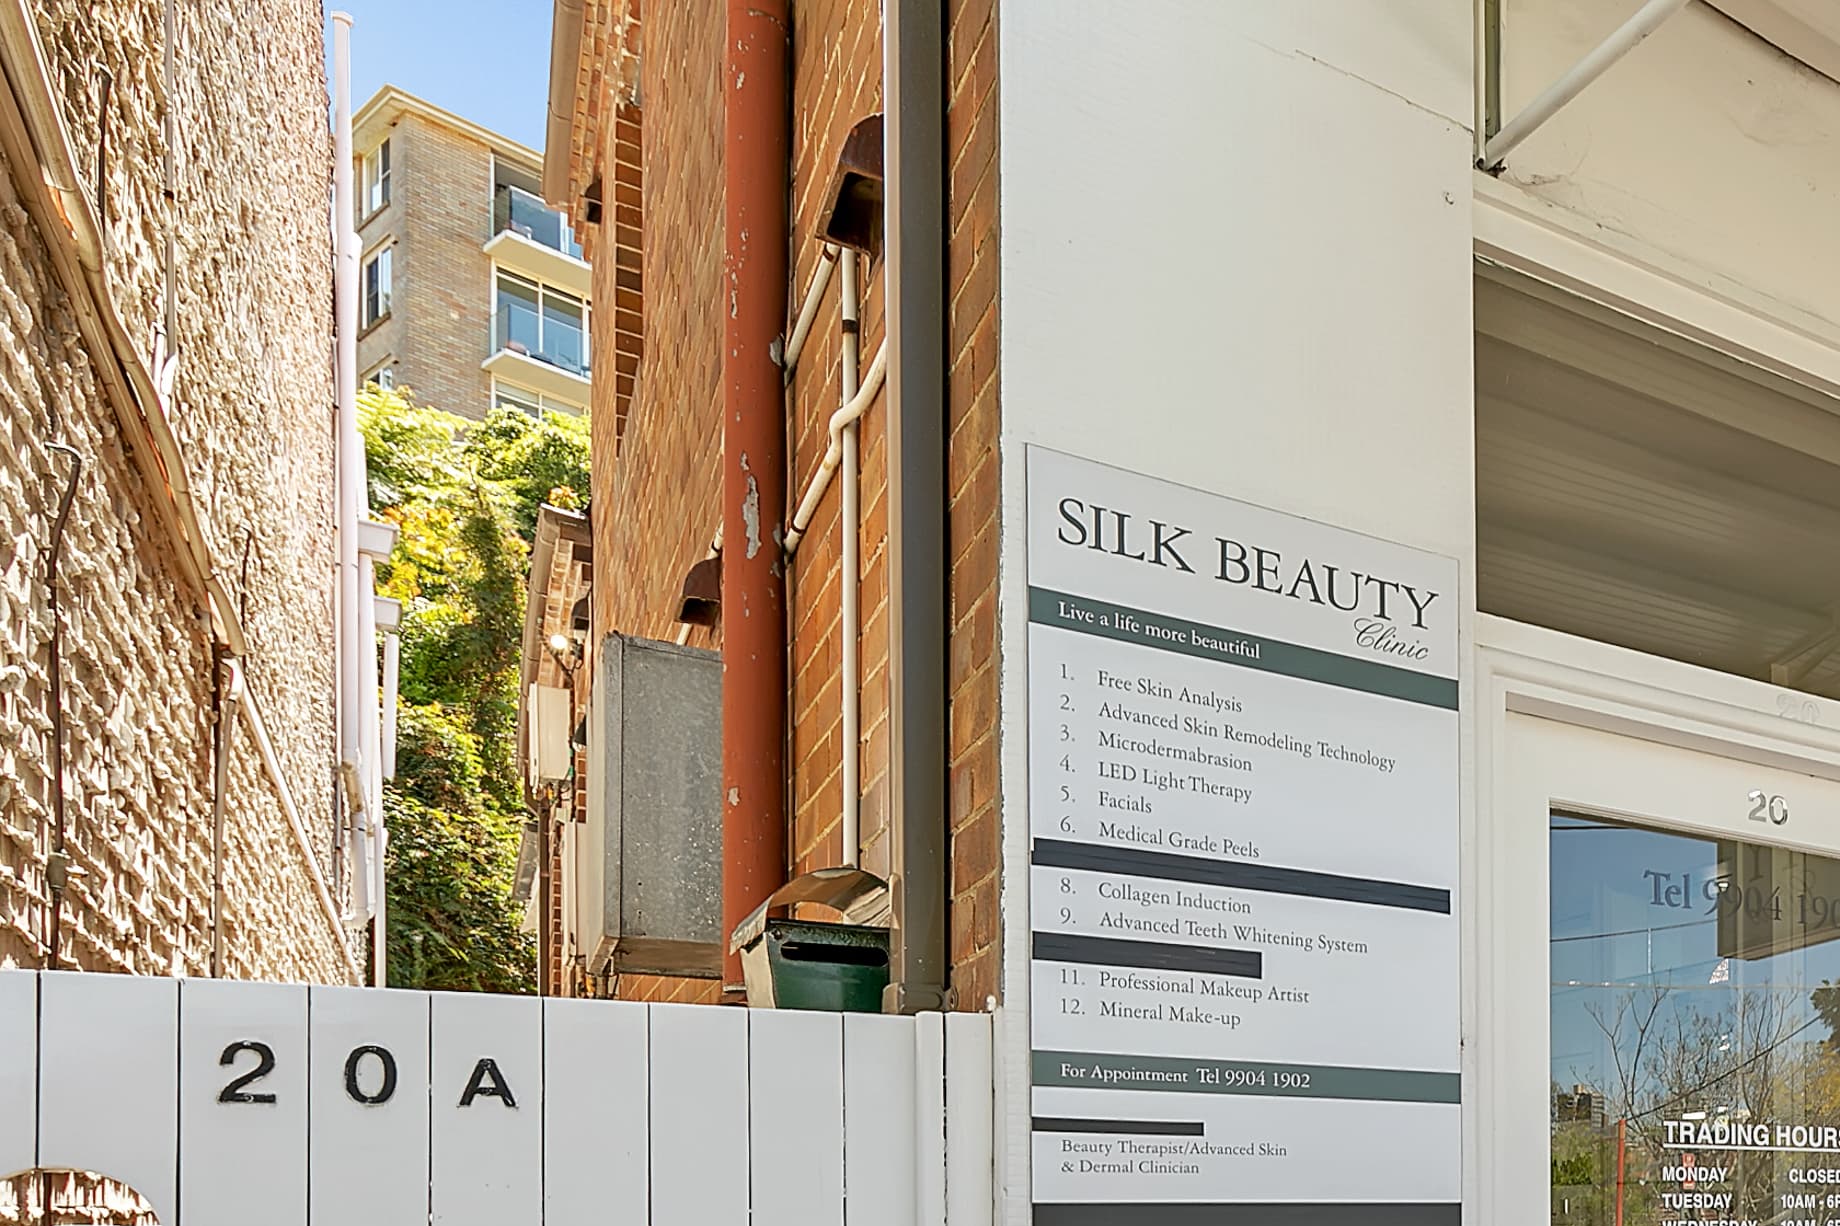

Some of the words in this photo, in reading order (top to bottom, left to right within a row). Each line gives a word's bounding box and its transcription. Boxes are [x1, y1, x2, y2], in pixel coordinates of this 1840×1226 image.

[1058, 498, 1195, 574] SILK
[1215, 538, 1438, 629] BEAUTY
[1059, 601, 1094, 624] Live
[1100, 612, 1108, 626] a
[1115, 613, 1139, 633] life
[1145, 624, 1186, 644] more
[1191, 629, 1260, 659] beautiful
[1354, 618, 1429, 660] Clinic
[1061, 664, 1074, 680] 1.
[1098, 670, 1132, 693] Free
[1138, 678, 1172, 700] Skin
[1179, 687, 1242, 714] Analysis
[1061, 695, 1075, 711] 2.
[1099, 702, 1179, 732] Advanced
[1184, 717, 1217, 738] Skin
[1224, 724, 1312, 757] Remodeling
[1317, 741, 1395, 773] Technology
[1061, 725, 1075, 742] 3.
[1100, 730, 1252, 771] Microdermabrasion
[1061, 754, 1075, 773] 4.
[1099, 761, 1136, 783] LED
[1142, 767, 1184, 792] Light
[1189, 775, 1252, 803] Therapy
[1061, 786, 1075, 803] 5.
[1099, 792, 1152, 814] Facials
[1747, 788, 1789, 826] 20
[1061, 816, 1075, 833] 6.
[1100, 823, 1162, 846] Medical
[1169, 831, 1217, 852] Grade
[1223, 839, 1259, 858] Peels
[1061, 878, 1076, 894] 8.
[1099, 882, 1170, 907] Collagen
[1177, 891, 1250, 914] Induction
[1643, 869, 1690, 909] Tel
[1702, 877, 1783, 921] 9904
[1061, 908, 1076, 925] 9.
[1100, 913, 1179, 935] Advanced
[1185, 920, 1227, 940] Teeth
[1233, 925, 1312, 951] Whitening
[1318, 933, 1368, 954] System
[1061, 968, 1085, 986] 11.
[1100, 972, 1194, 995] Professional
[1200, 980, 1262, 1003] Makeup
[1268, 986, 1309, 1004] Artist
[1061, 999, 1085, 1015] 12.
[1100, 1002, 1162, 1021] Mineral
[1169, 1007, 1241, 1028] Make-up
[1061, 1063, 1085, 1077] For
[1091, 1065, 1188, 1086] Appointment
[1196, 1067, 1220, 1084] Tel
[1225, 1069, 1266, 1086] 9904
[1272, 1071, 1311, 1088] 1902
[1062, 1140, 1112, 1158] Beauty
[1117, 1141, 1255, 1158] Therapist/Advanced
[1259, 1143, 1287, 1157] Skin
[1663, 1121, 1769, 1145] TRADING
[1061, 1161, 1074, 1174] &
[1080, 1159, 1134, 1174] Dermal
[1139, 1159, 1199, 1175] Clinician
[1662, 1166, 1727, 1182] MONDAY
[1662, 1193, 1732, 1209] TUESDAY
[1781, 1194, 1816, 1209] 10AM
